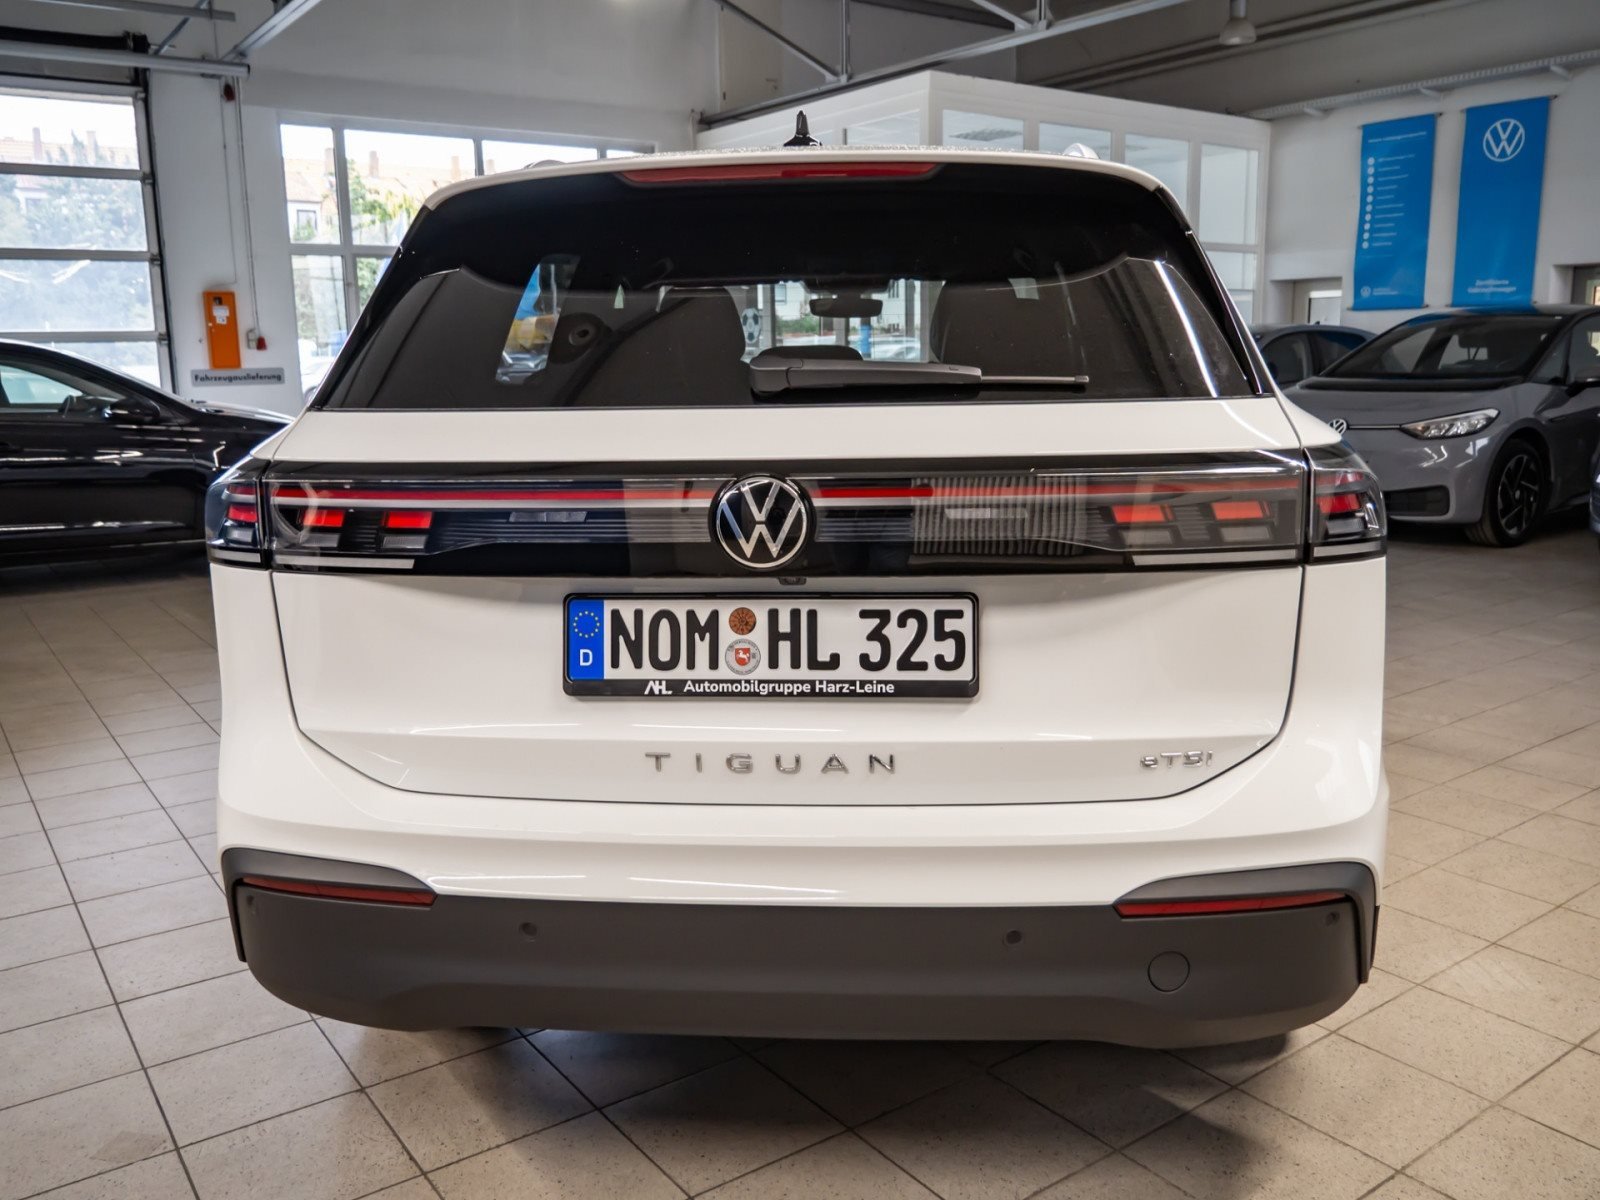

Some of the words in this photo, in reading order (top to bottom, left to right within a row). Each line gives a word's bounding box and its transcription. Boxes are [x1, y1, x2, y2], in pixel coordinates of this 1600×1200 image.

[194, 372, 282, 382] Fahrzeugauslieferung
[611, 608, 719, 671] NOM
[768, 608, 840, 671] HL
[859, 609, 966, 671] 325
[579, 649, 593, 666] D
[683, 680, 811, 696] Automobilgruppe
[815, 680, 895, 694] Harz-Leine
[645, 752, 896, 774] TIGUAN
